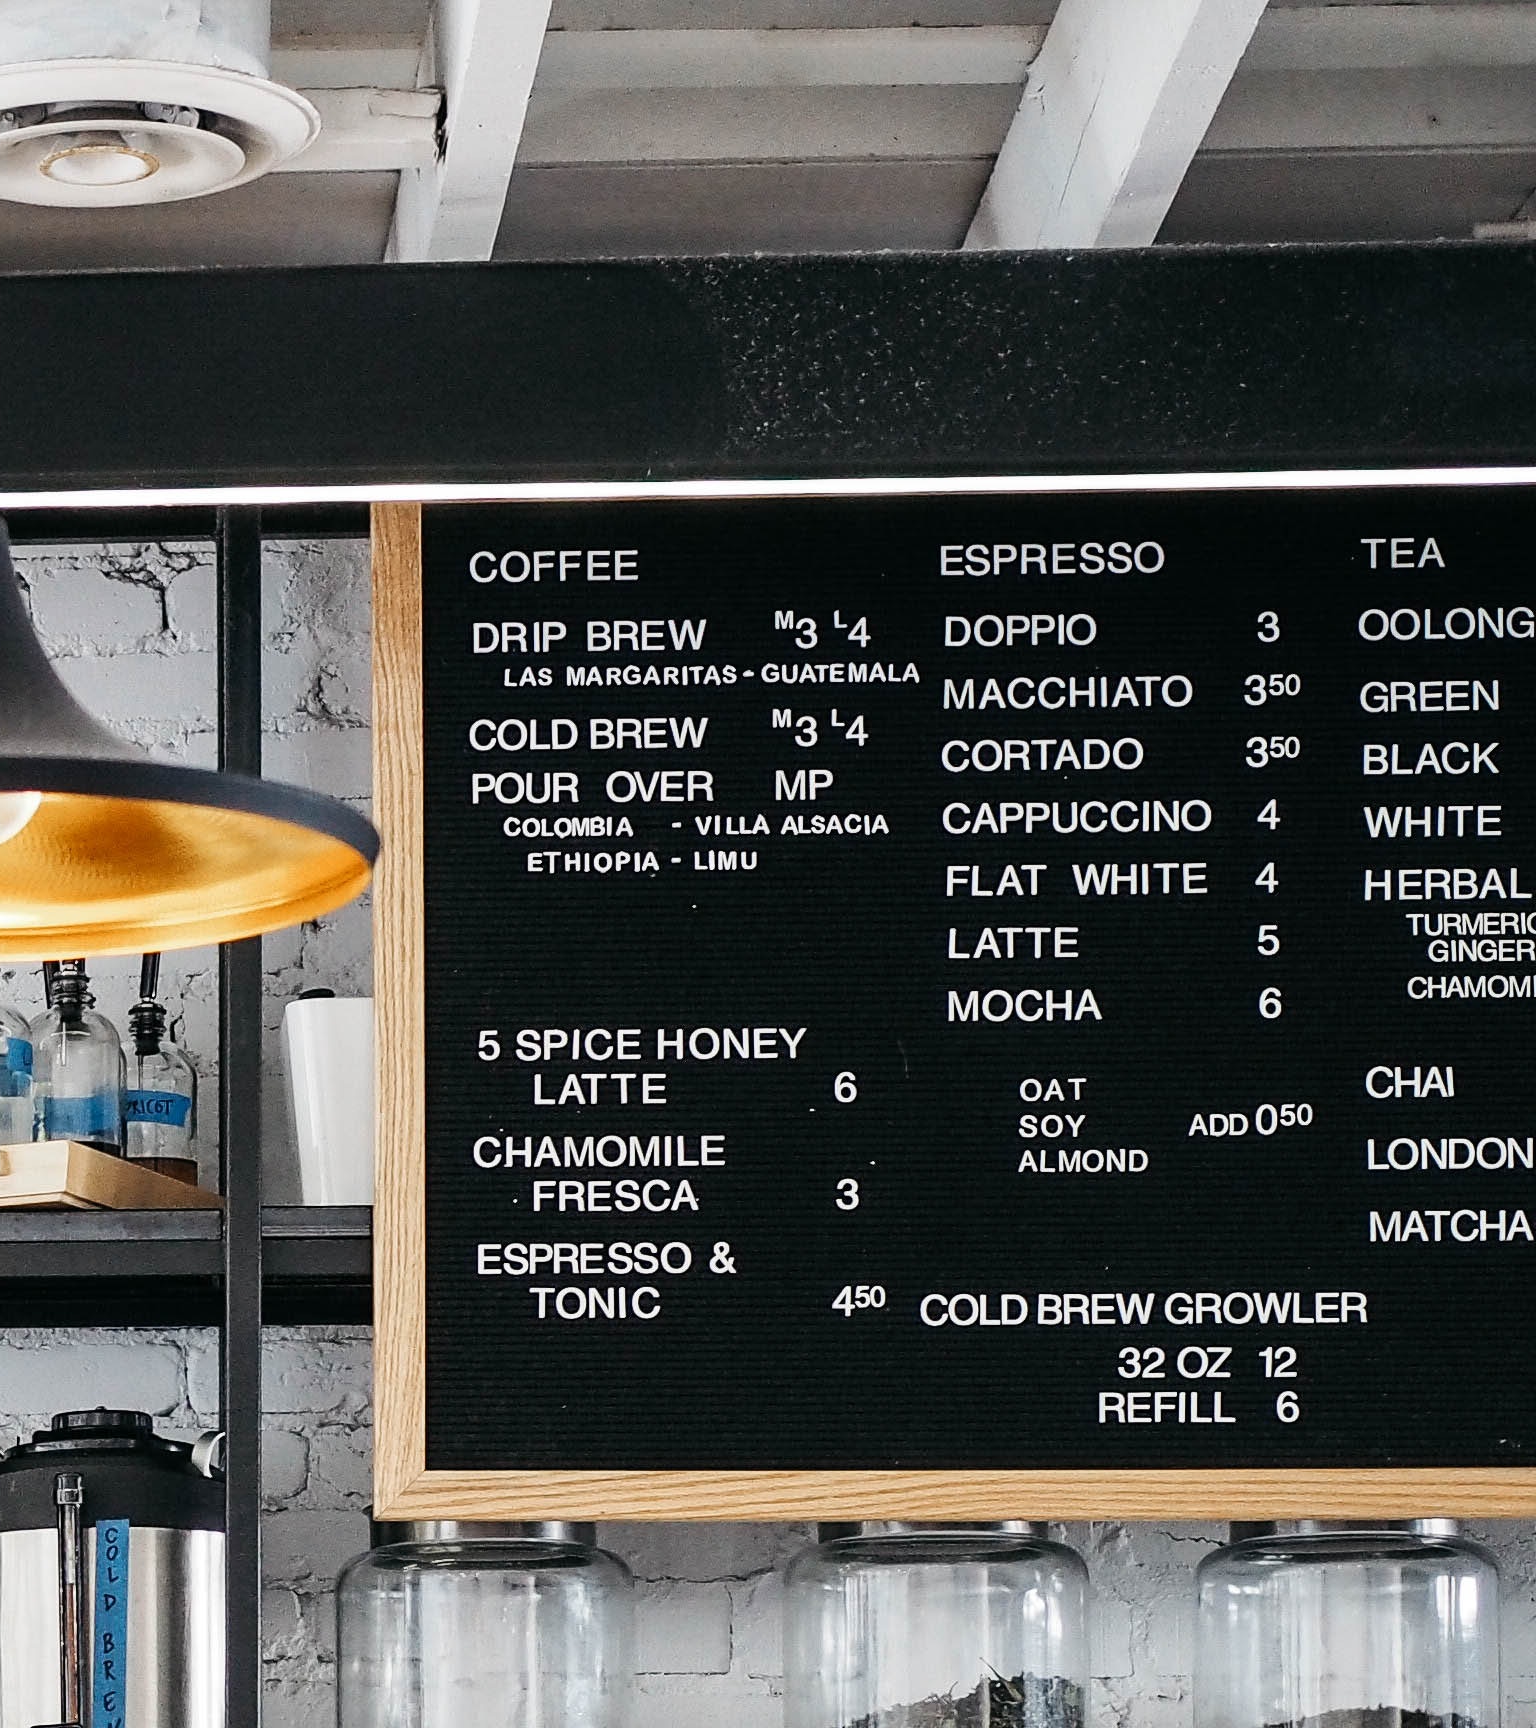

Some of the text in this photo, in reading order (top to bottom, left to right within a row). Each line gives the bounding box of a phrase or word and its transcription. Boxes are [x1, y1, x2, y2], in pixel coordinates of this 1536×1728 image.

[470, 550, 638, 582] COFFEE
[941, 542, 1164, 576] ESPRESSO
[1361, 538, 1445, 568] TEA
[473, 622, 566, 653] DRIP
[587, 619, 706, 651] BREW
[945, 612, 1279, 646] DOPPIO 3
[1359, 607, 1534, 640] OOLONG
[504, 667, 552, 686] LAS
[944, 675, 1192, 709] MACCHIATO
[1360, 680, 1499, 712] GREEN
[470, 719, 578, 751] COLD
[590, 717, 708, 749] BREW
[942, 738, 1143, 772] CORTADO
[1364, 742, 1499, 774] BLACK
[472, 770, 833, 804] POUR OVER MP
[504, 816, 633, 838] COLOMBIA
[695, 814, 770, 835] VILLA
[781, 814, 889, 835] ALSACIA
[943, 799, 1280, 834] CAPPUCCINO 4
[1364, 806, 1501, 837] WHITE
[528, 851, 659, 873] ETHIOPIA
[694, 850, 757, 870] LIMU
[947, 863, 1278, 896] FLAT WHITE 4
[1365, 868, 1532, 900] HERBAL
[949, 925, 1279, 958] LATTE 5
[1428, 940, 1535, 962] GINGER
[949, 988, 1281, 1021] MOCHA 6
[479, 1028, 806, 1061] 5 SPICE HONEY
[535, 1072, 857, 1104] LATTE 6
[1020, 1078, 1086, 1101] OAT
[1366, 1066, 1454, 1098] CHAI
[1019, 1115, 1085, 1137] SOY
[1189, 1114, 1248, 1137] ADD
[474, 1135, 725, 1168] CHAMOMILE
[1018, 1149, 1148, 1172] ALMOND
[1368, 1137, 1533, 1170] LONDON
[534, 1179, 859, 1211] FRESCA 3
[1370, 1210, 1533, 1241] MATCHA
[478, 1242, 736, 1275] ESPRESSO &
[529, 1287, 660, 1319] TONIC
[920, 1292, 1367, 1326] COLD BREW GROWLER
[1118, 1347, 1297, 1378] 32 OZ 12
[1099, 1391, 1299, 1423] REFILL 6
[102, 1526, 122, 1612] COLD
